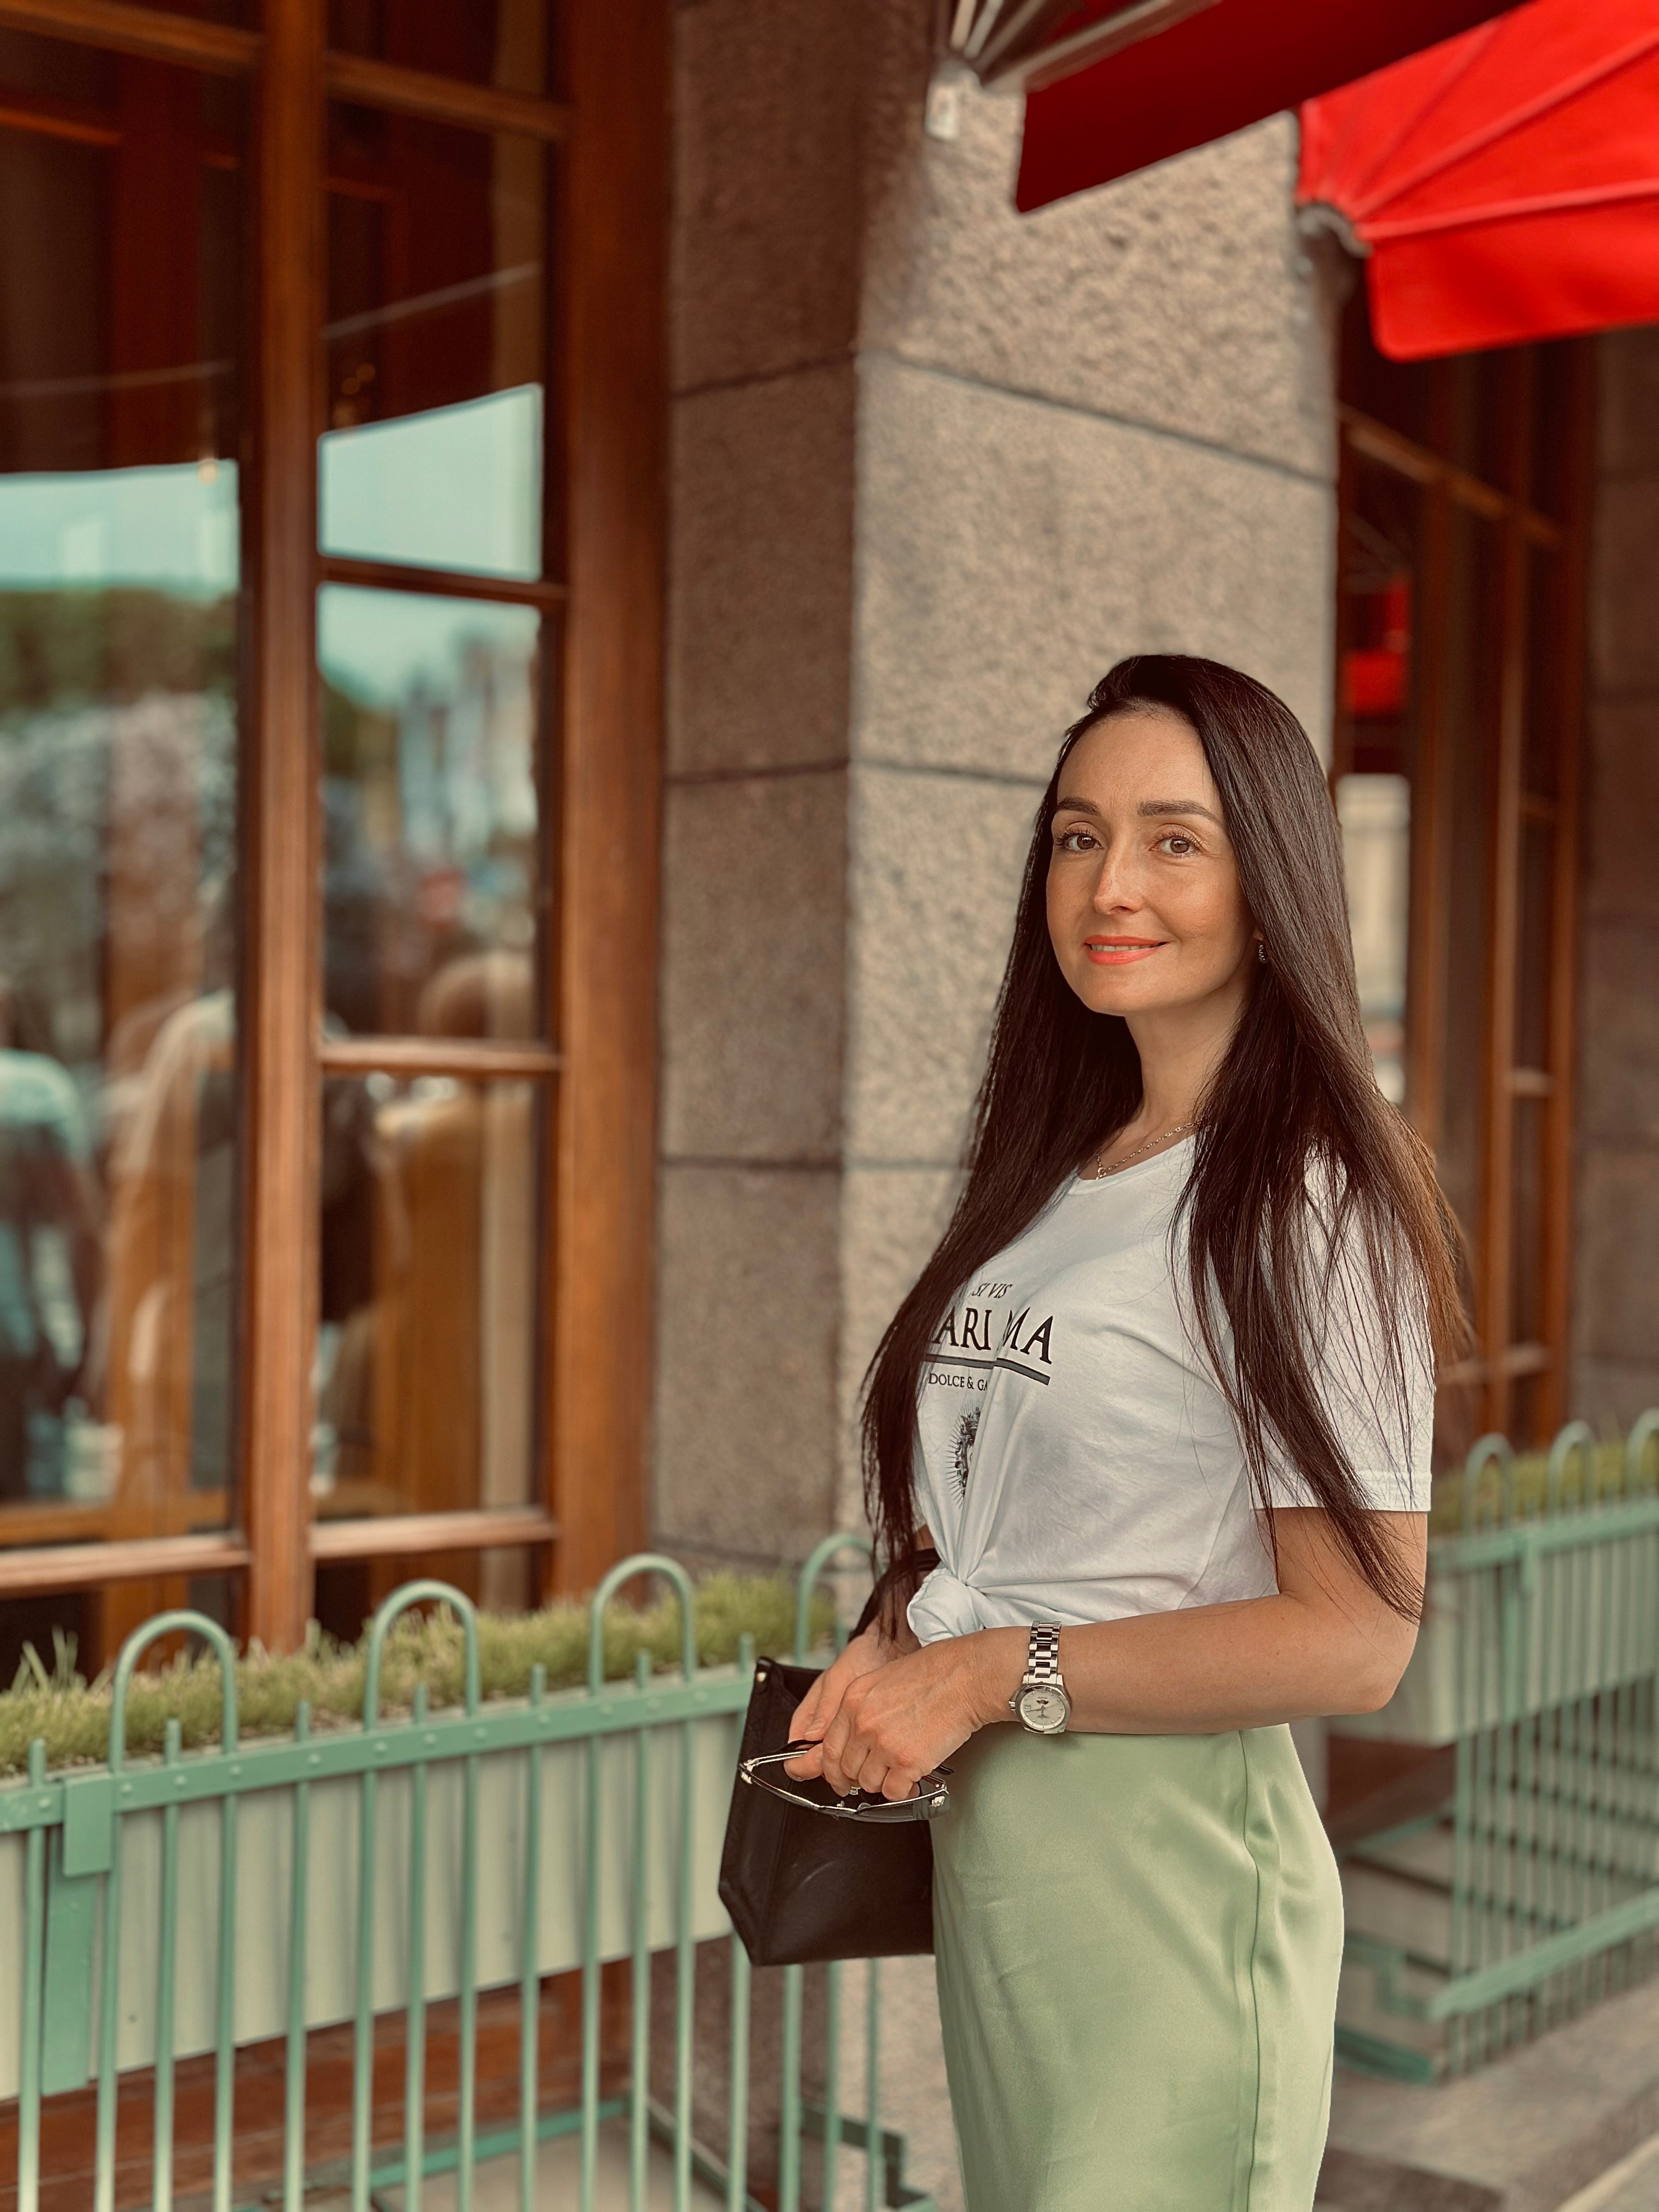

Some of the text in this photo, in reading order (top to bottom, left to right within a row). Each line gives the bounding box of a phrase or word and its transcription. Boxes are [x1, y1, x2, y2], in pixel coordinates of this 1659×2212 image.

[971, 1283, 1013, 1299] SI VIS
[928, 1373, 965, 1388] DOLCE
[967, 1376, 975, 1390] &
